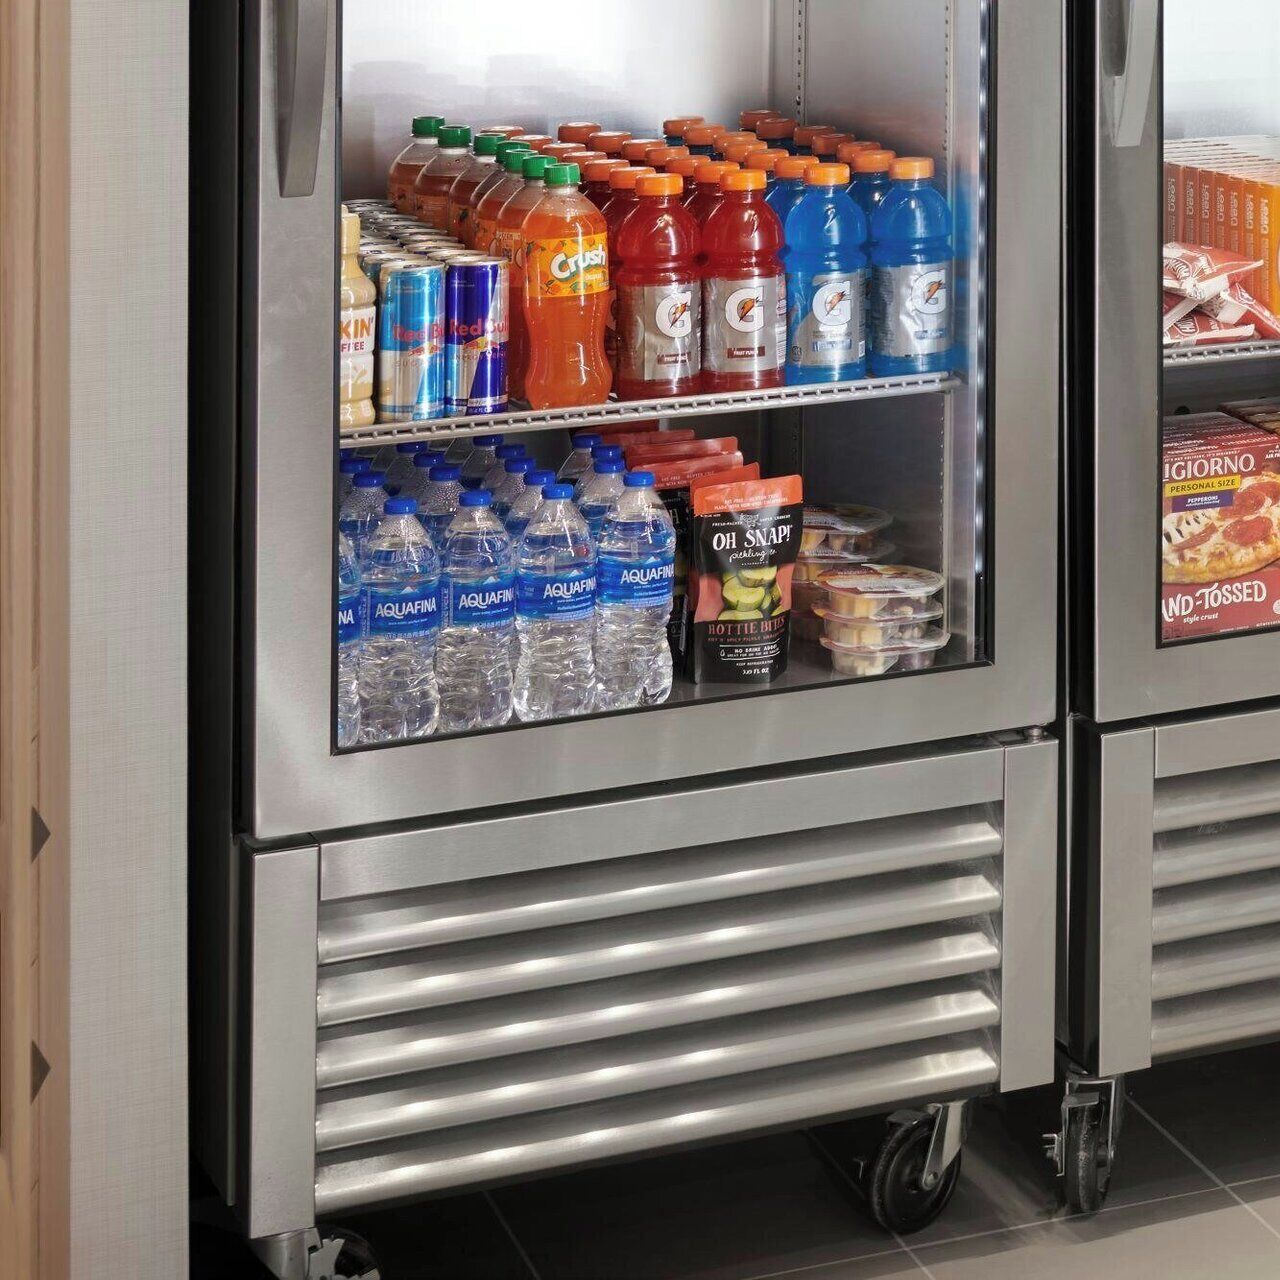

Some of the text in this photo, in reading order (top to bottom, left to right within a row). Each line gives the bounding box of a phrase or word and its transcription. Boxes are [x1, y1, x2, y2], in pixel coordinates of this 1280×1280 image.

[550, 244, 606, 279] Crush
[725, 288, 764, 333] G
[1170, 478, 1236, 494] PERSONAL SIZE
[712, 524, 791, 551] OH SNAP!
[729, 549, 767, 563] pickling
[375, 596, 437, 619] AQUAFINA
[708, 621, 757, 635] HOTTIE
